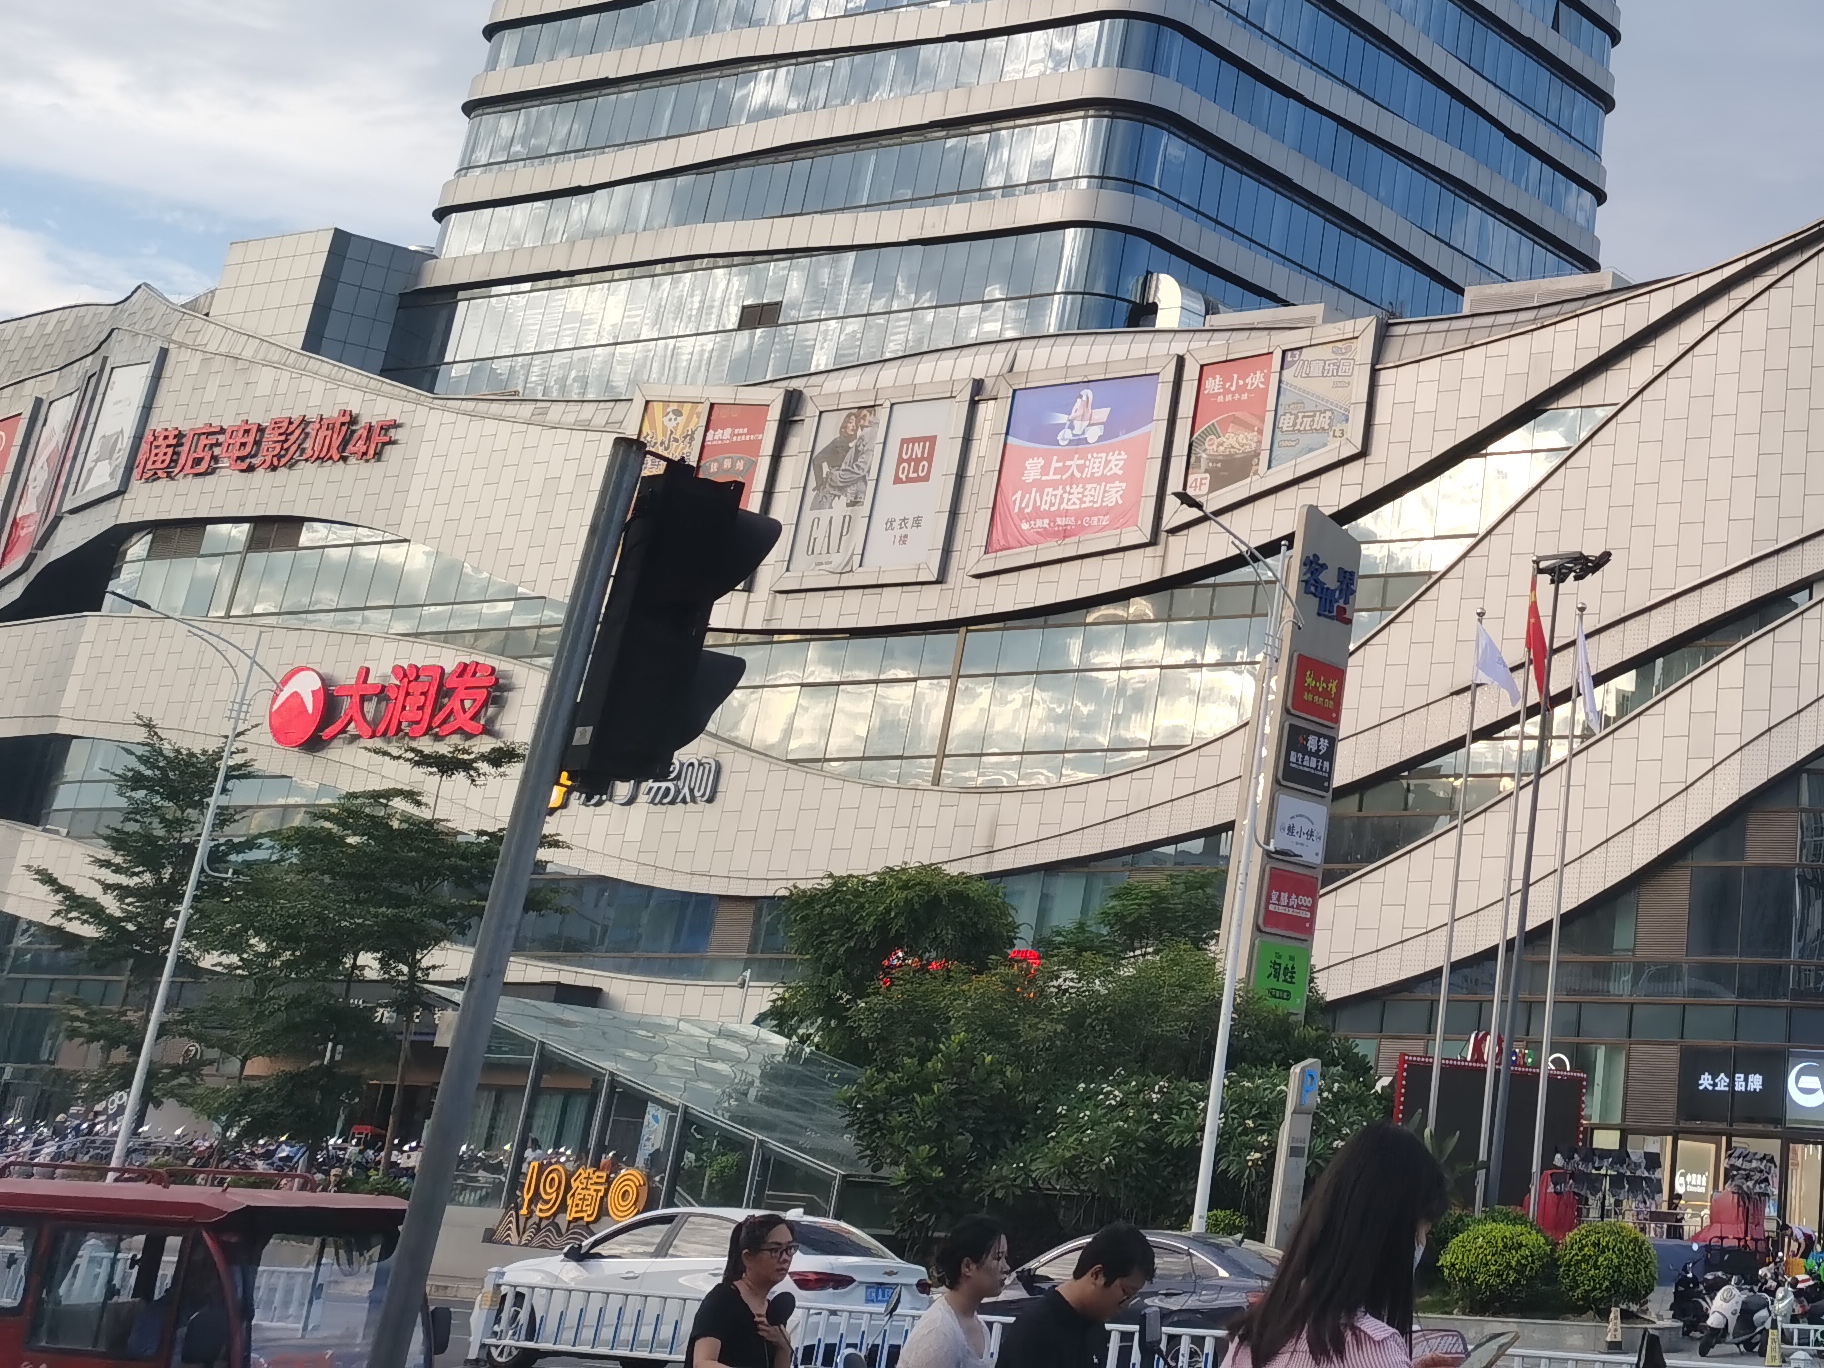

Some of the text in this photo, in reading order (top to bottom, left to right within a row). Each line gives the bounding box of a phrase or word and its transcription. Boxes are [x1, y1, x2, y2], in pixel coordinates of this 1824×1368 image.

[1294, 359, 1355, 377] 儿童乐园
[1277, 410, 1334, 432] 电玩城
[902, 441, 930, 459] UNI
[898, 461, 929, 481] QLO
[1021, 450, 1127, 483] 掌上大润发
[1011, 481, 1127, 513] 1小时送到家
[885, 515, 923, 531] 优衣库
[806, 515, 852, 556] GAP
[321, 661, 500, 739] 大润发
[1300, 1070, 1318, 1106] P
[1698, 1071, 1763, 1092] 央企品牌
